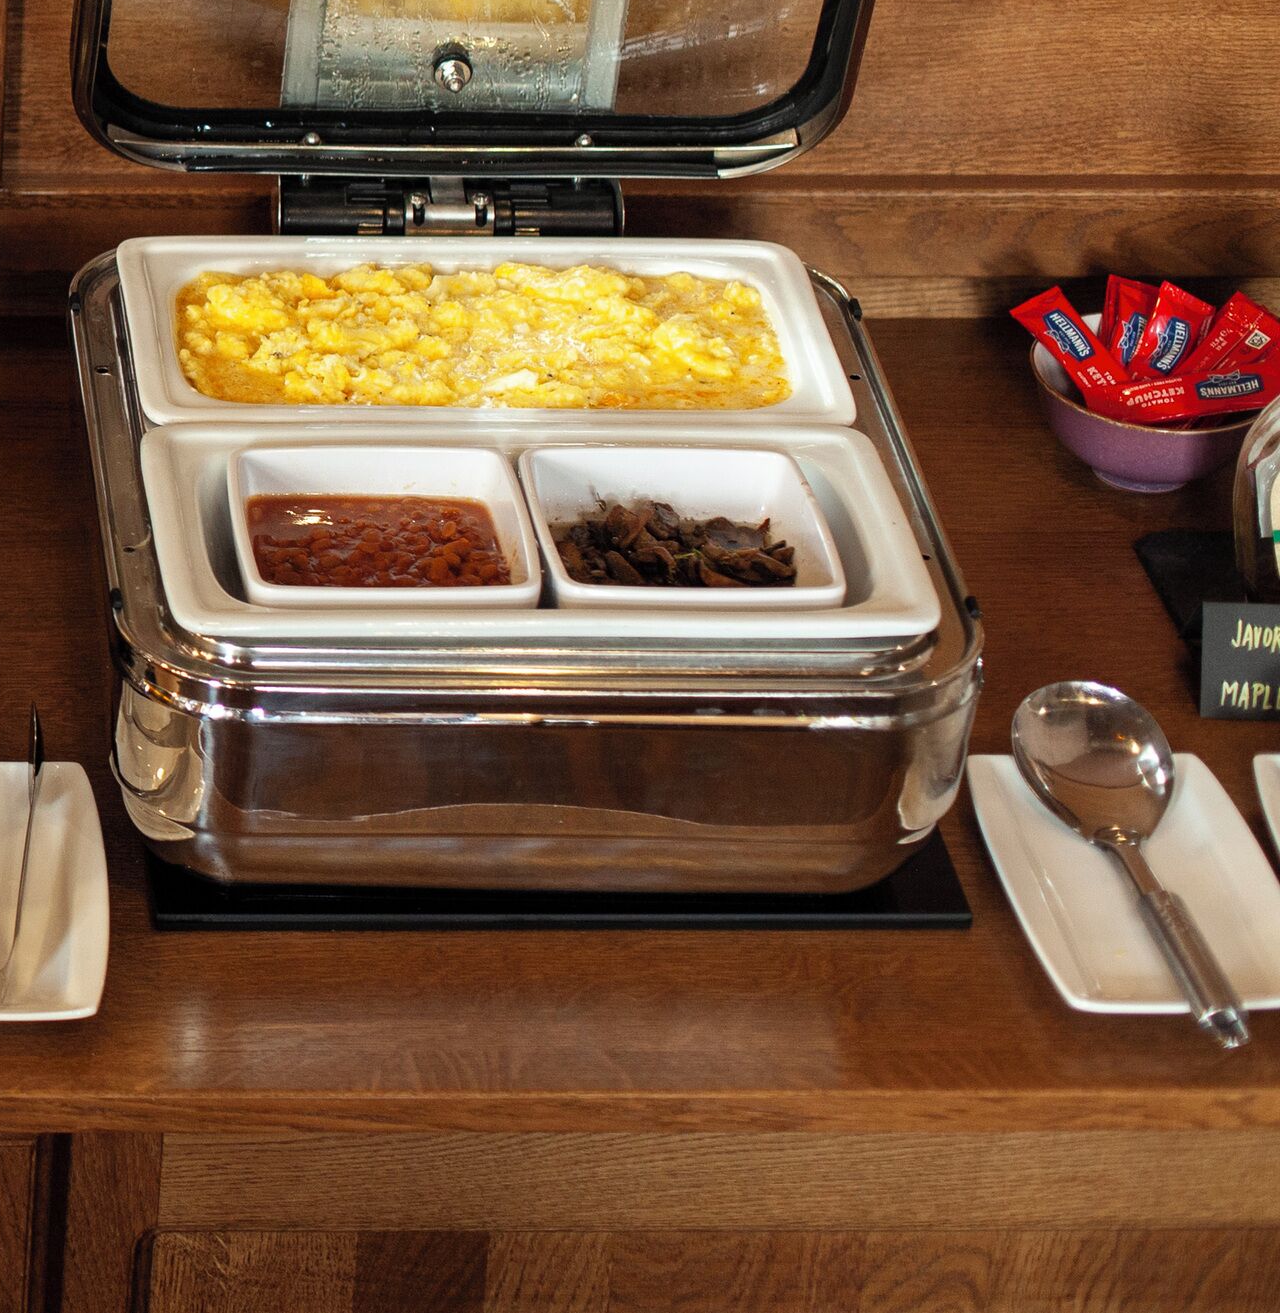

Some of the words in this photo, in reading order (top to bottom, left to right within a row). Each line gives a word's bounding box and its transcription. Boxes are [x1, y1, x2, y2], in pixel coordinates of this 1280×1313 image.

[1049, 313, 1090, 357] HELLMANN'S
[1157, 322, 1186, 370] HELLMANN'S
[1087, 366, 1107, 386] KET
[1126, 386, 1185, 406] KETCHUP
[1200, 378, 1260, 397] HELLMANN'S
[1141, 398, 1175, 408] TOMATO
